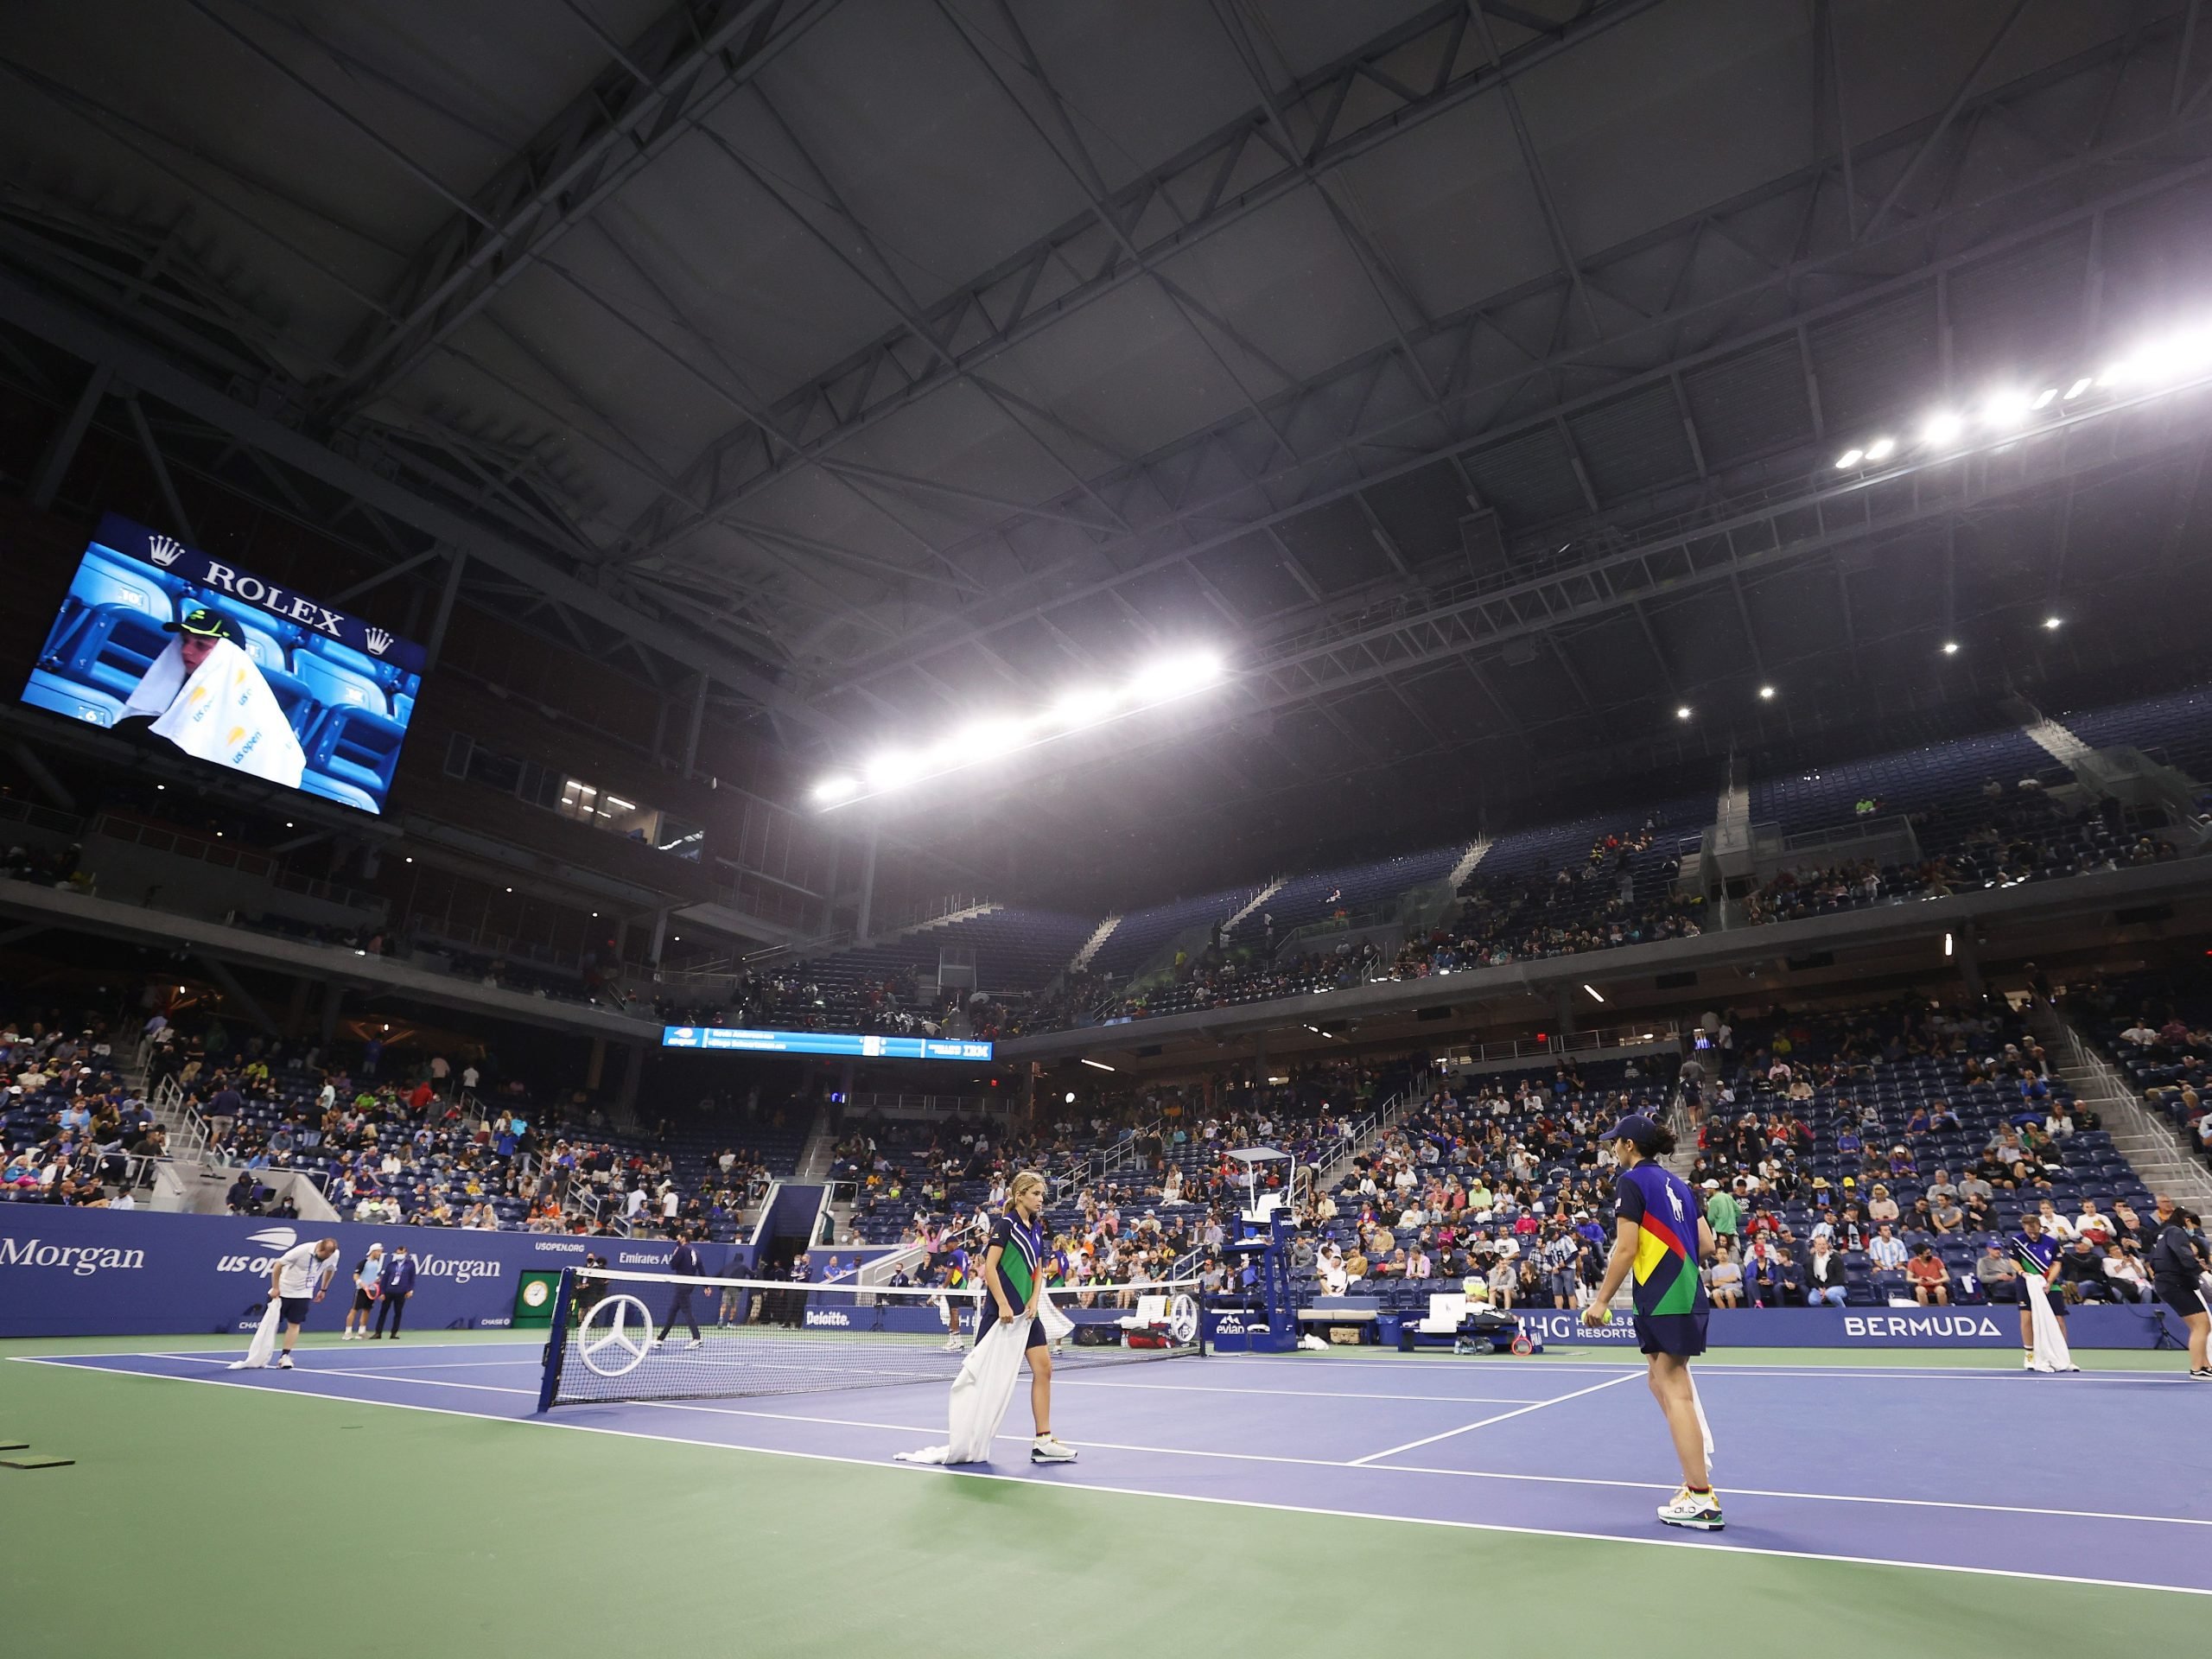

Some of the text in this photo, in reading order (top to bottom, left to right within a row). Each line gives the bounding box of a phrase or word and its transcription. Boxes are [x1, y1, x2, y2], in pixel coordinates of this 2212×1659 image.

[202, 561, 345, 638] ROLEX
[232, 730, 263, 764] us open
[535, 1242, 585, 1253] USOPEN.ORG
[0, 1238, 145, 1276] Morgan
[619, 1252, 659, 1264] Emirates
[216, 1255, 274, 1279] us op
[480, 1318, 503, 1326] CHASE
[806, 1311, 850, 1326] Deloitte.
[1575, 1317, 1625, 1327] HLS
[238, 1321, 262, 1330] CHA
[1217, 1325, 1245, 1334] evian
[1844, 1317, 2003, 1337] BERMUDA
[1576, 1329, 1637, 1339] RESORTS
[1669, 1506, 1696, 1515] OLO
